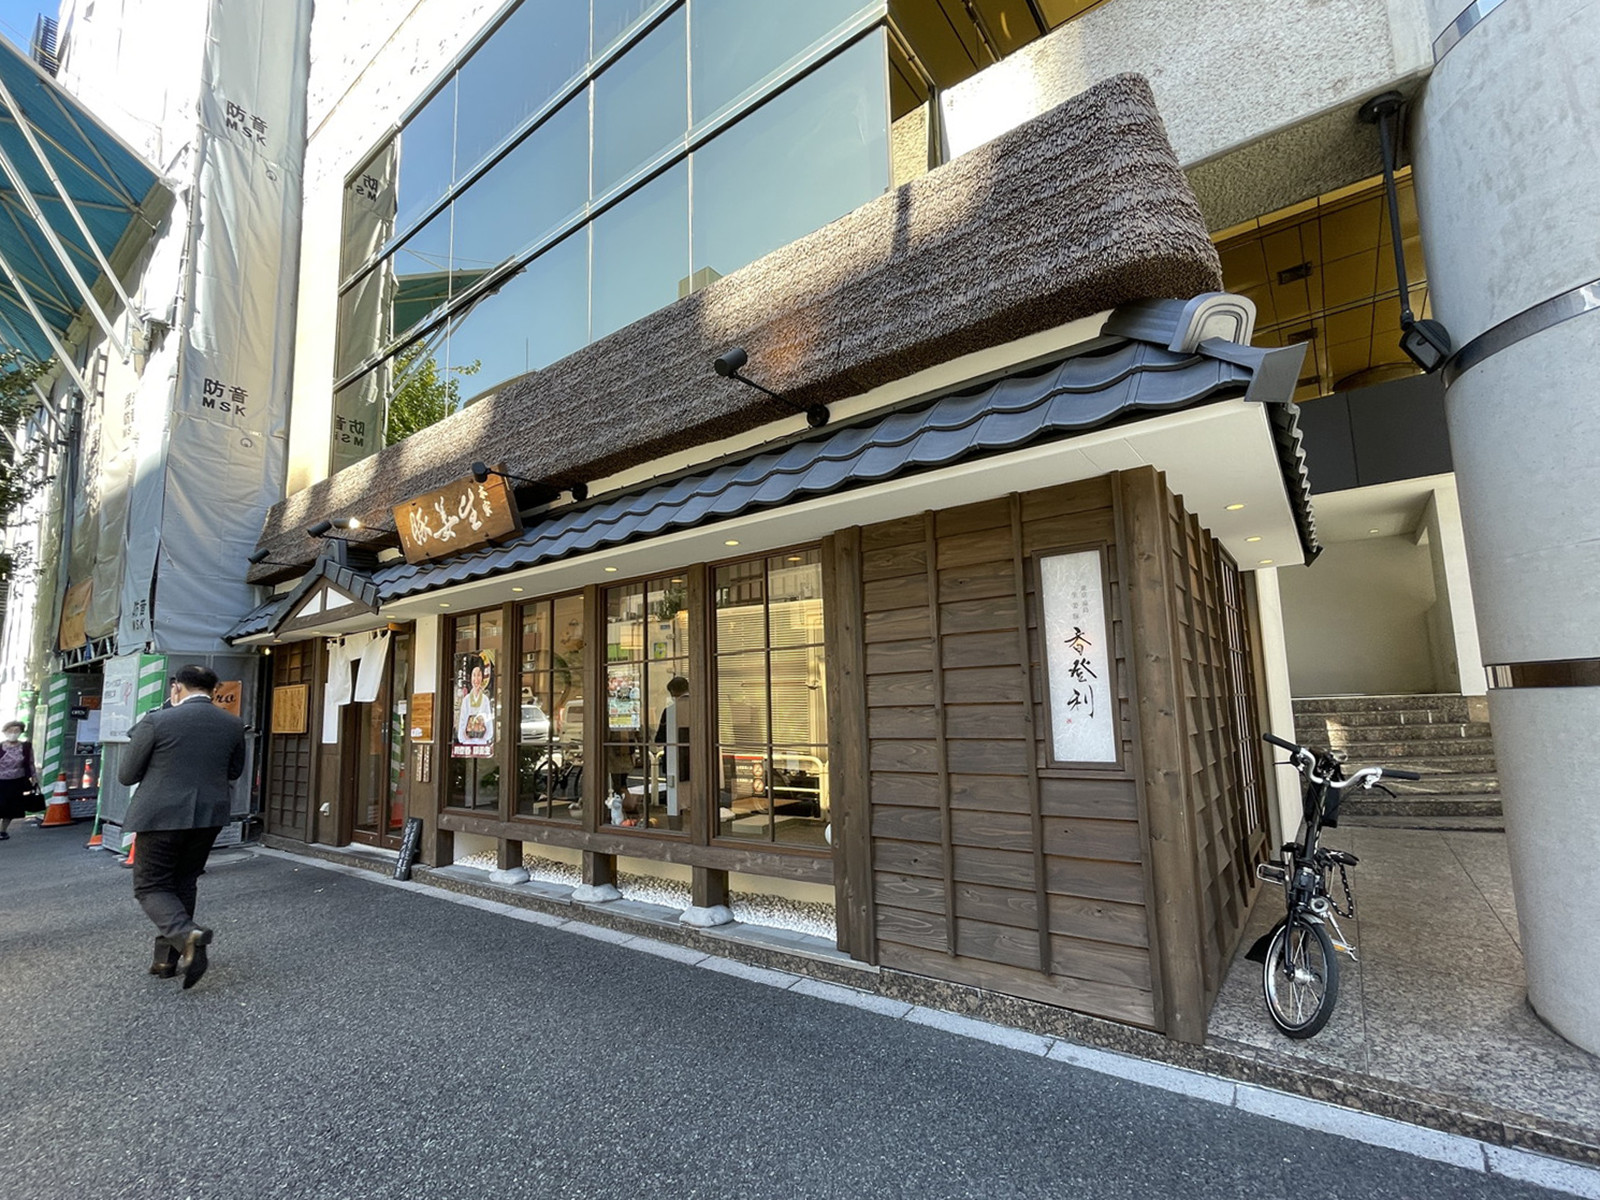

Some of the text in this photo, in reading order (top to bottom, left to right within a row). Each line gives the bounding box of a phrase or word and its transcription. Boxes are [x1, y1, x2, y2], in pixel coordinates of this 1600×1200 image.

[226, 100, 268, 134] 防音
[226, 117, 267, 147] MSK
[203, 378, 249, 404] 防音
[202, 396, 246, 417] MSK
[1063, 626, 1098, 719] 香登利
